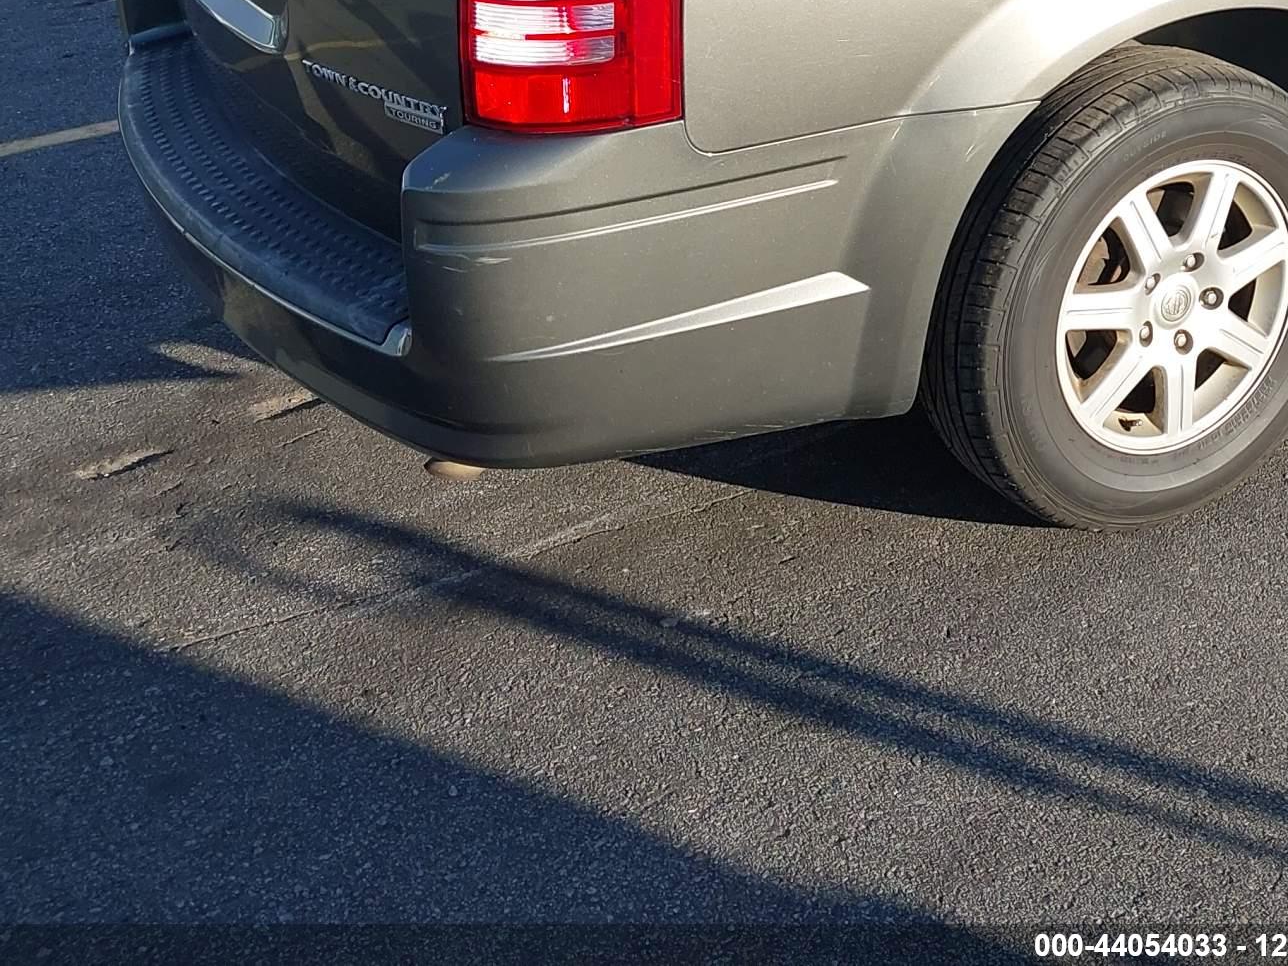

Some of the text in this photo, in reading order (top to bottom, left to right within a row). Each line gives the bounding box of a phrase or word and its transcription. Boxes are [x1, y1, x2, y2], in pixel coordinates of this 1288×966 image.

[302, 59, 346, 86] TOWN
[358, 82, 447, 117] COUNTRY
[389, 106, 437, 130] TOURING
